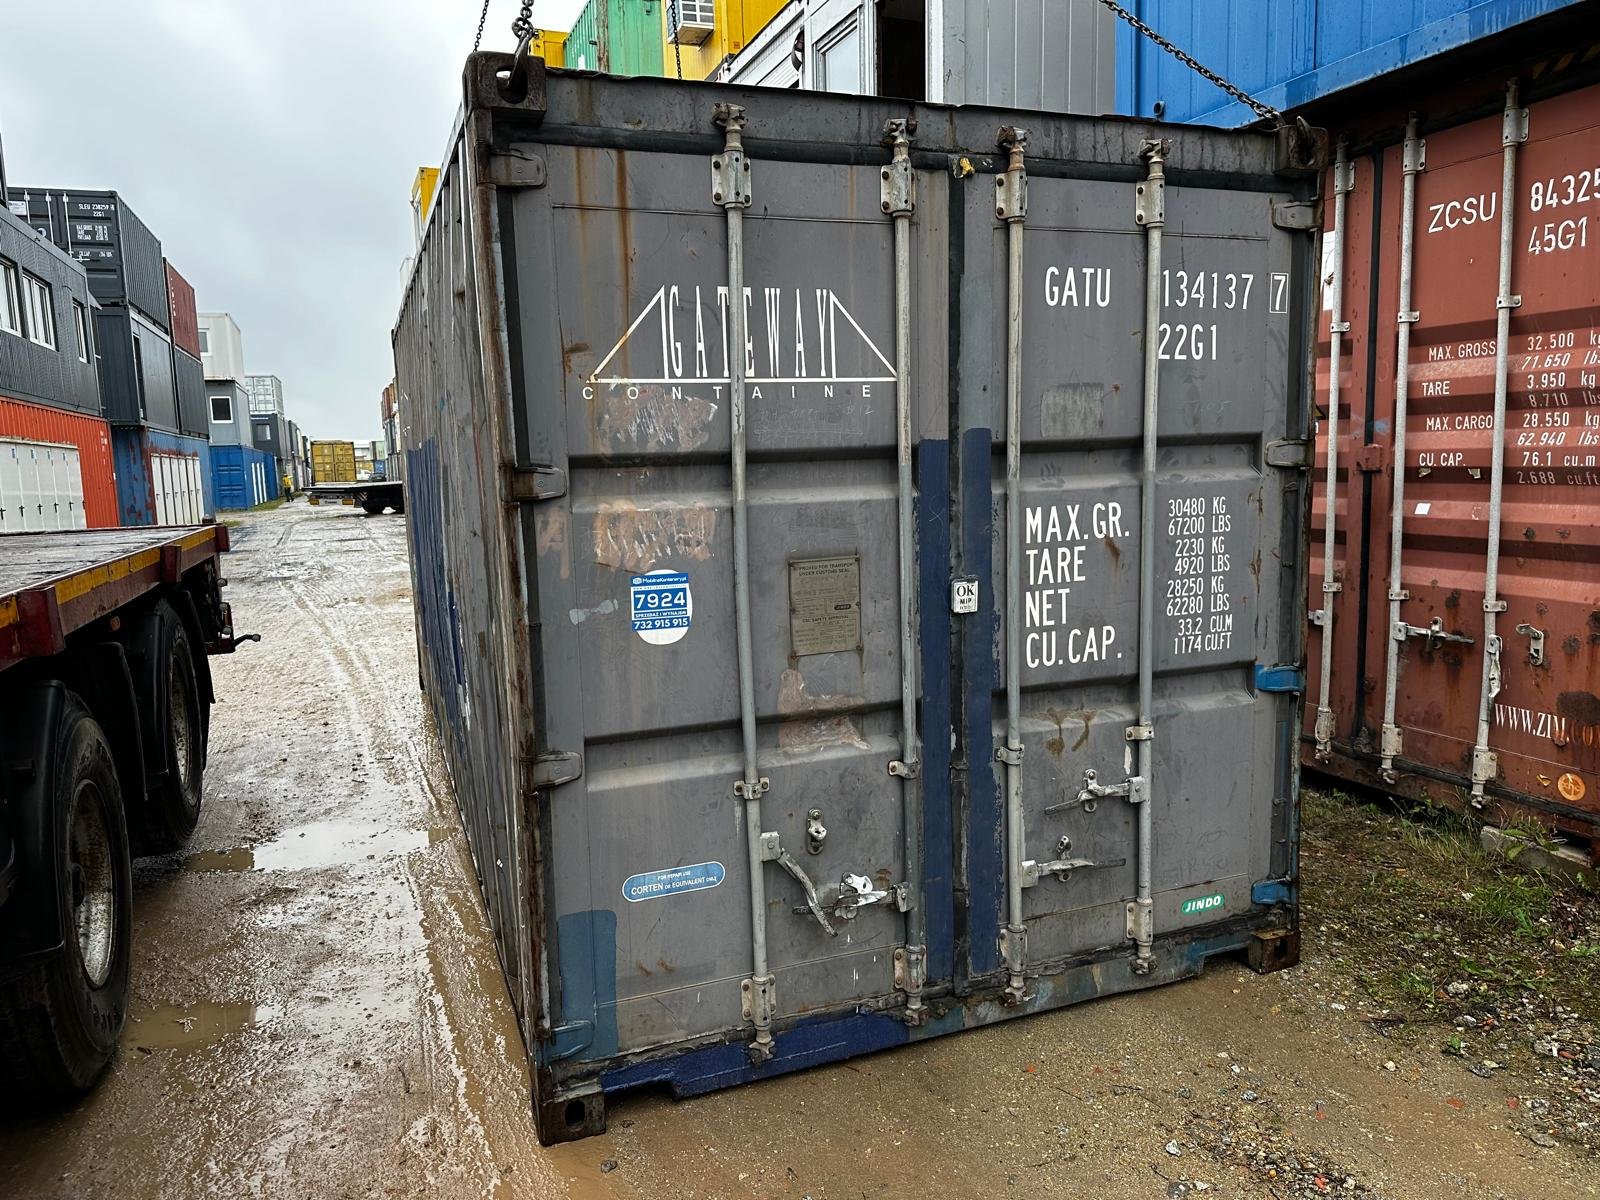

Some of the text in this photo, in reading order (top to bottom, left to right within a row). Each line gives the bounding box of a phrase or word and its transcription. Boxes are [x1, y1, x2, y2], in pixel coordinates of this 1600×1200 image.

[1428, 192, 1496, 234] ZCSU
[1528, 216, 1588, 255] 45G1
[1044, 266, 1286, 310] GATU 134137 7
[669, 285, 828, 378] GATEWAY
[1158, 323, 1217, 360] 22G1
[1528, 332, 1574, 350] 32.500
[1428, 341, 1496, 362] MAX. GROSS
[1522, 352, 1570, 370] 71.650
[1422, 381, 1450, 396] TARE
[1527, 370, 1596, 389] 3.950 kg
[582, 386, 871, 400] CONTAINE
[1528, 392, 1568, 408] 8.710
[1426, 414, 1493, 431] MAX. CARGO
[1523, 410, 1600, 430] 28.550 kg
[1518, 431, 1600, 446] 62.940 lbs
[1419, 452, 1466, 467] CU. CAP.
[1522, 452, 1596, 466] 76.1 cu.m
[1517, 472, 1600, 486] 2.688 cu.ft
[1168, 496, 1226, 517] 30480 KG
[1168, 515, 1231, 536] 67200 LBS
[1176, 536, 1224, 556] 2230 KG
[1026, 546, 1086, 586] TARE
[1174, 554, 1230, 576] 4920 LBS
[957, 585, 974, 596] OK
[1167, 576, 1224, 597] 28250 KG
[635, 592, 686, 608] 7924
[1026, 588, 1070, 628] NET
[1166, 594, 1230, 616] 62280 LBS
[634, 618, 688, 630] 732 915 915
[1178, 614, 1232, 636] 33.2 CU.M
[1174, 632, 1232, 654] 1174 CU.FT
[631, 883, 664, 895] CORTEN
[672, 876, 705, 888] EQUIVALENT
[1186, 896, 1221, 912] JINDO
